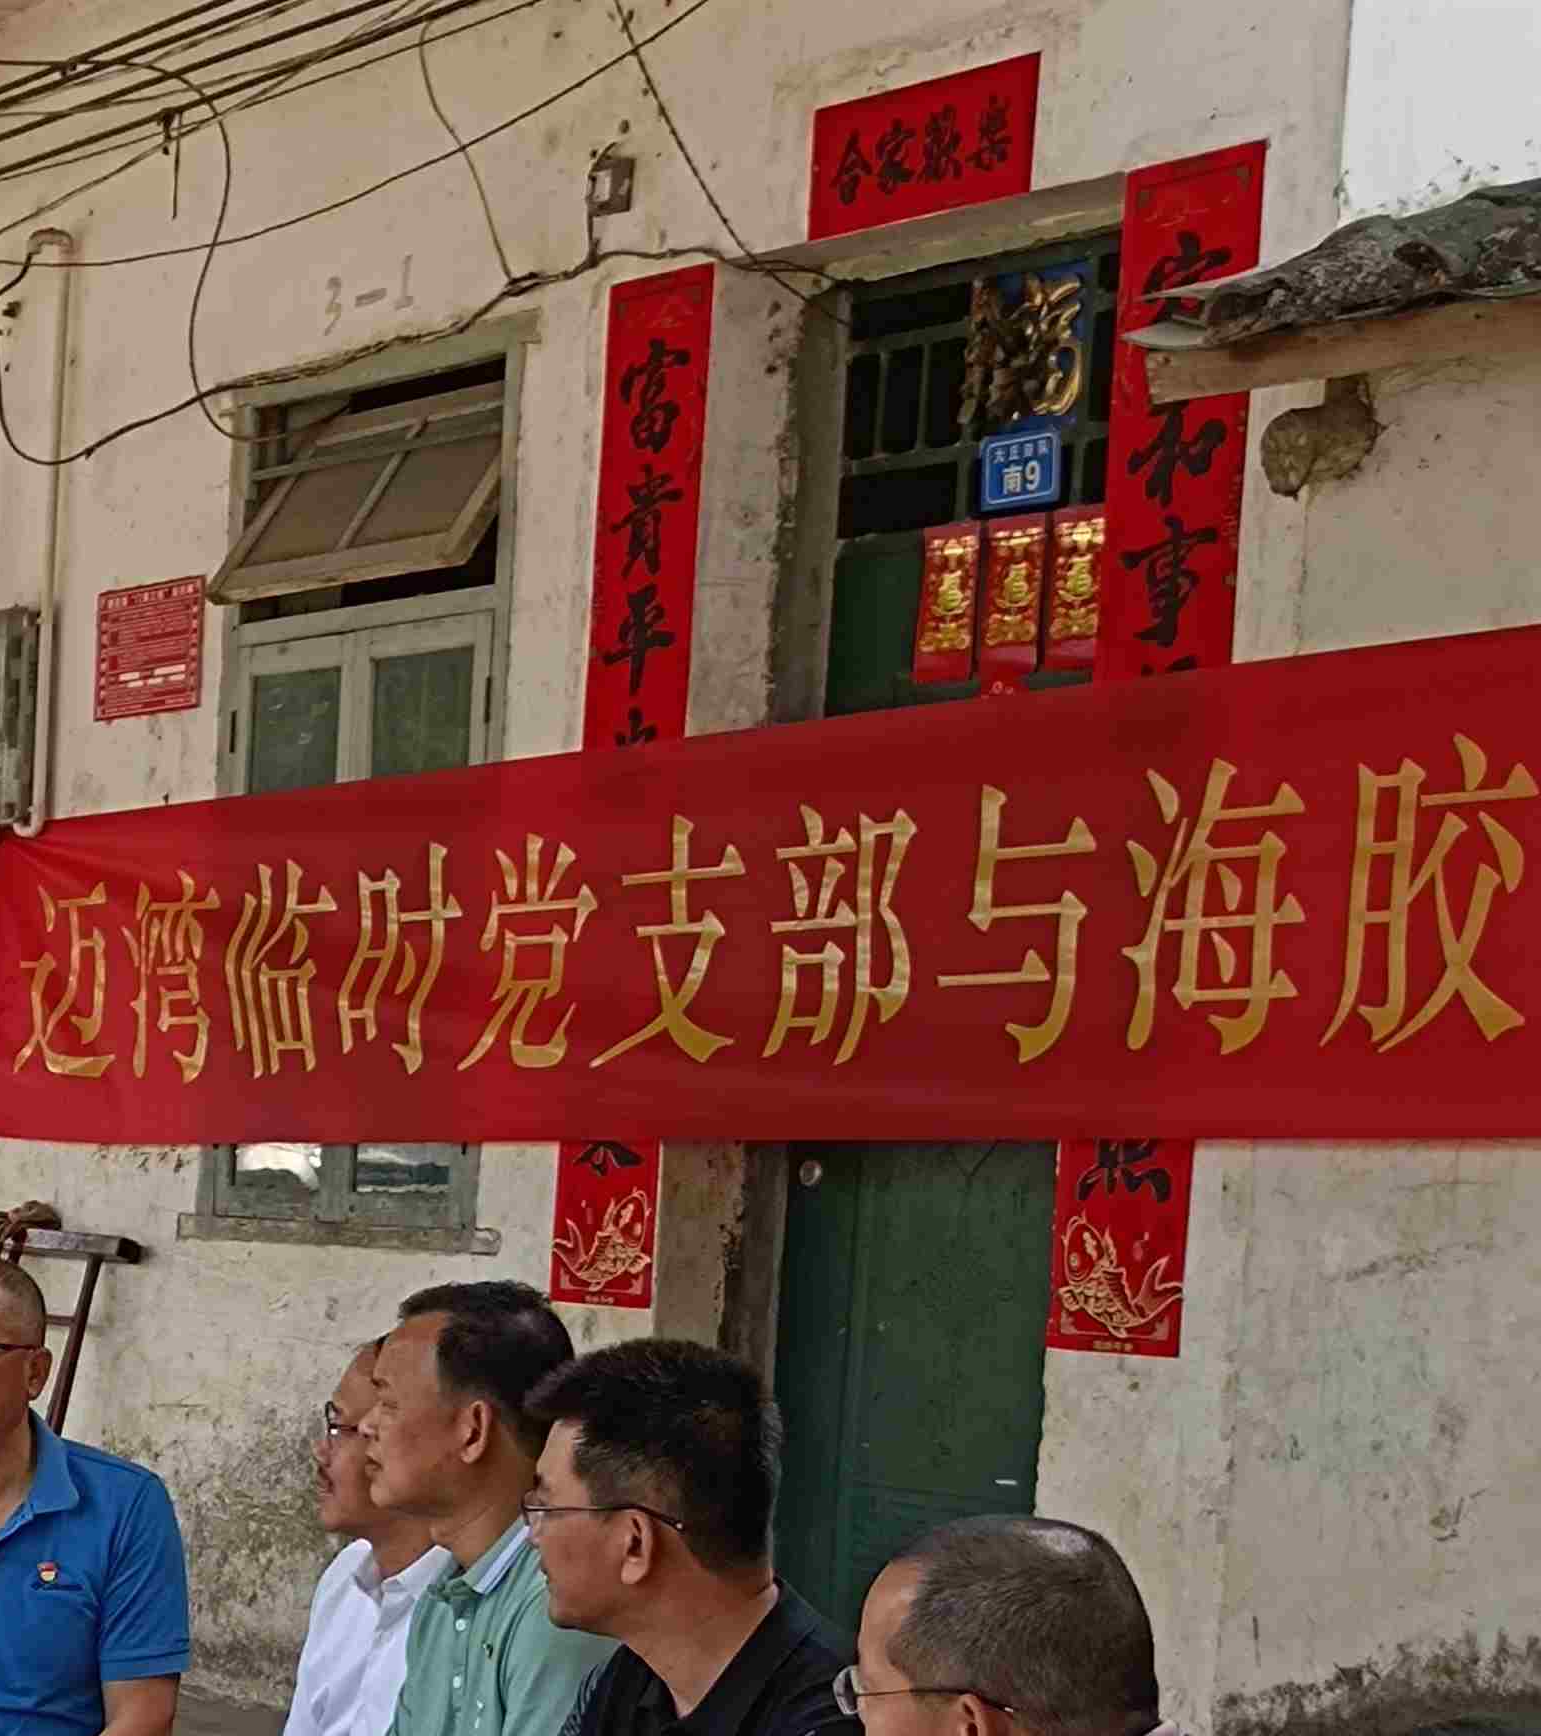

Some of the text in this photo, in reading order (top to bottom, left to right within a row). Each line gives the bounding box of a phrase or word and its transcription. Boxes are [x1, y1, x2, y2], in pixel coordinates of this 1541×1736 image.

[14, 733, 1540, 1084] 迈湾临时党支部与海胶
